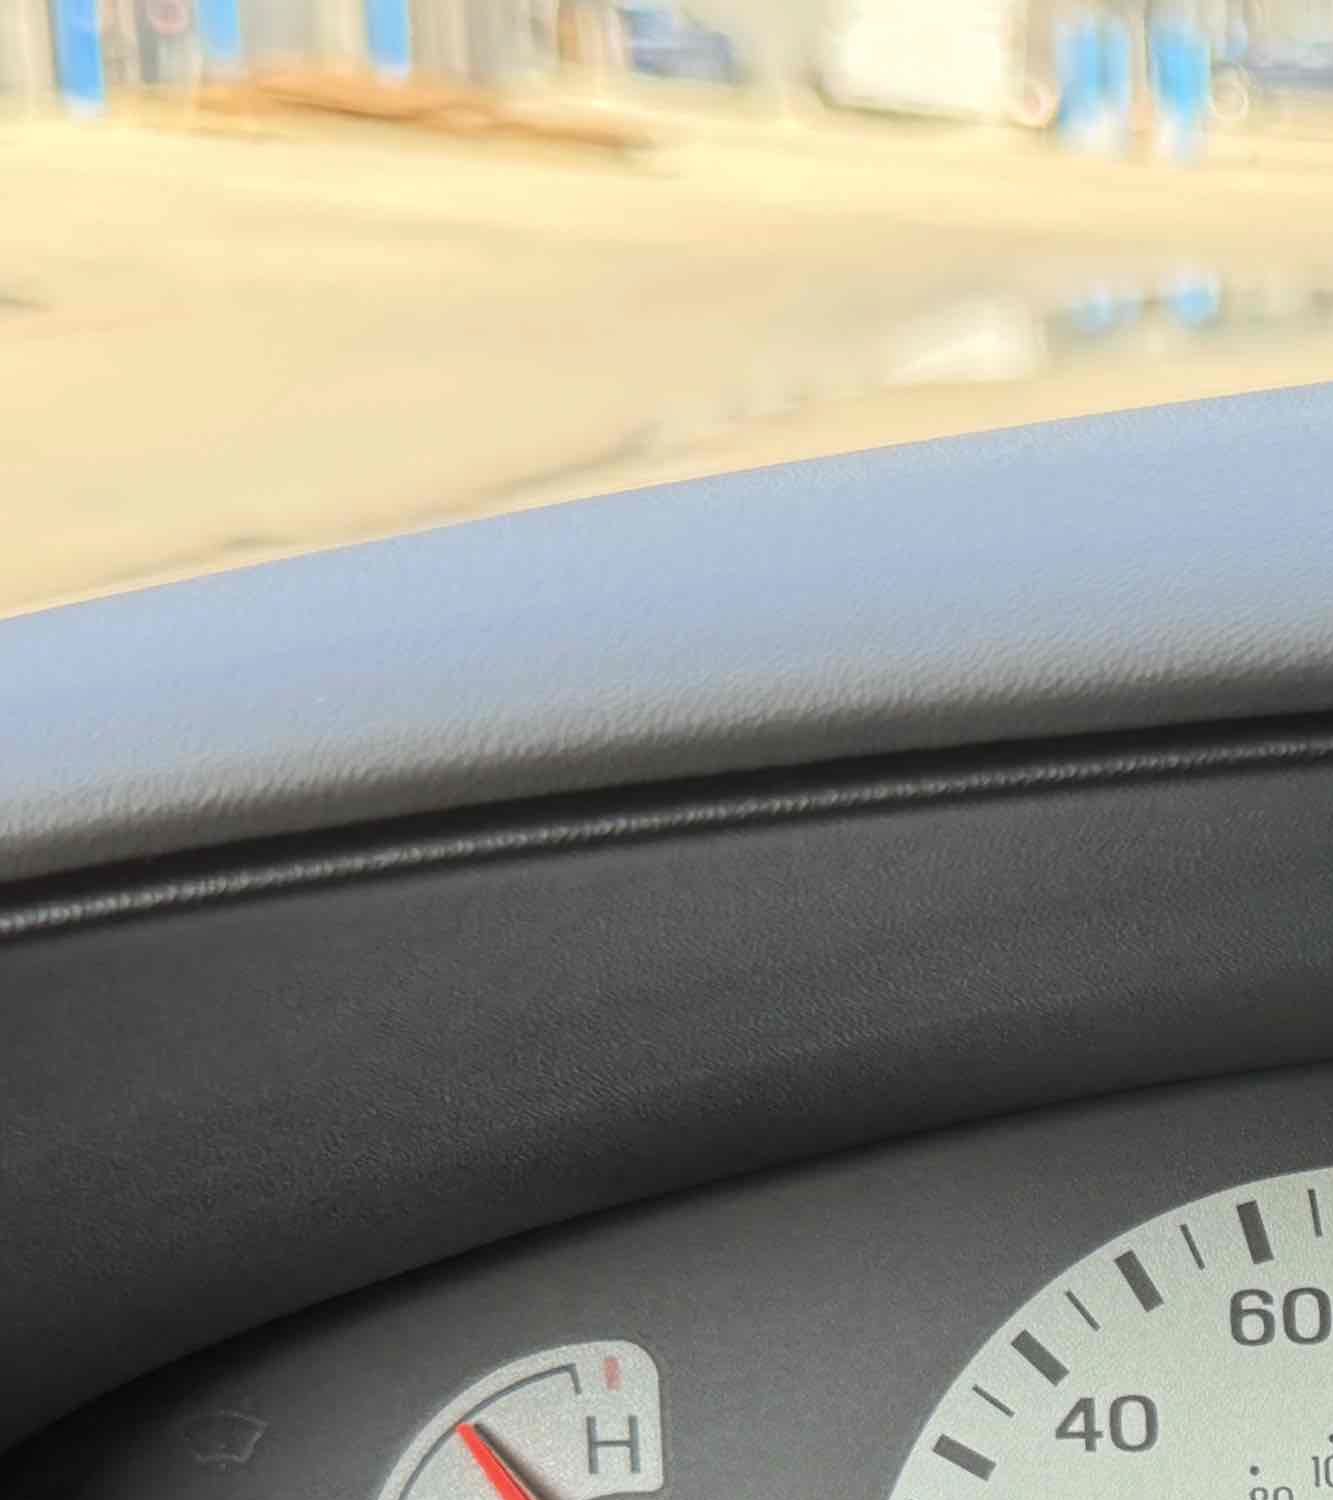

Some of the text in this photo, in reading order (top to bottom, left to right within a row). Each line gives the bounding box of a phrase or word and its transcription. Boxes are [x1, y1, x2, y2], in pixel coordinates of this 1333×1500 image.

[1230, 1287, 1331, 1346] 60
[586, 1415, 640, 1474] H
[1056, 1395, 1158, 1452] 40
